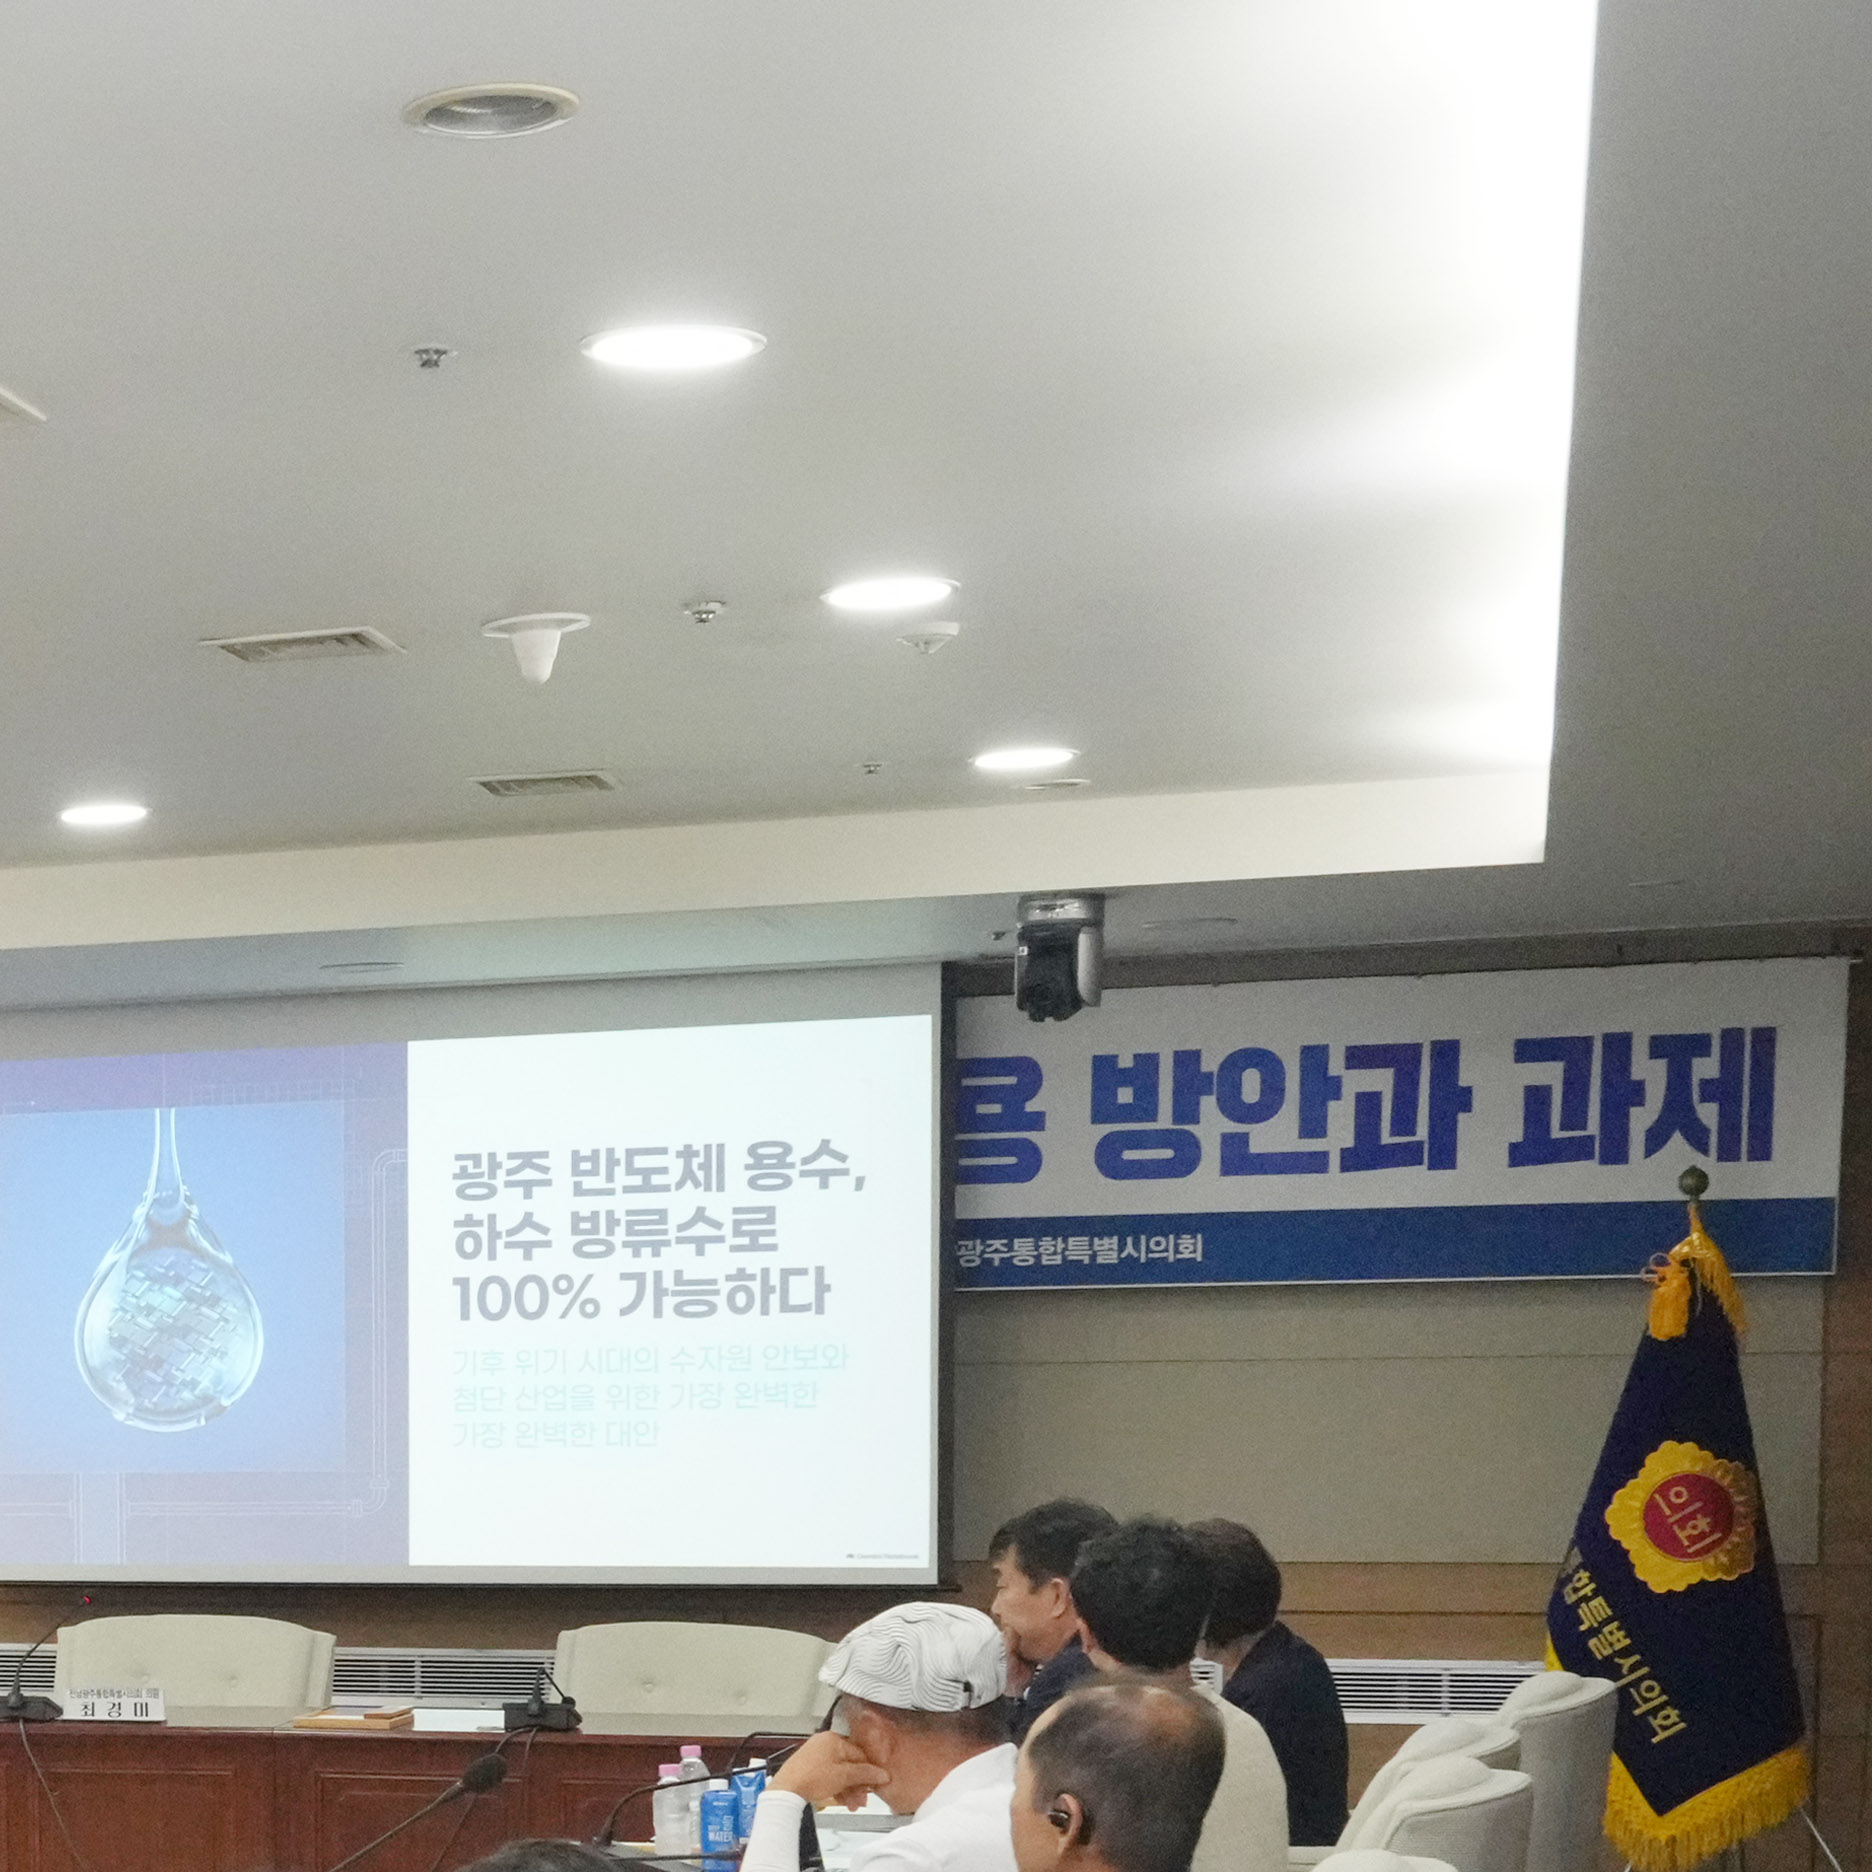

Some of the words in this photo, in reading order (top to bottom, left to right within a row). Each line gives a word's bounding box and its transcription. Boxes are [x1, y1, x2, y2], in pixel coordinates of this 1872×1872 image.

[1091, 1039, 1472, 1180] 방안과
[1508, 1026, 1777, 1168] 과제
[452, 1150, 553, 1202] 광주
[570, 1143, 726, 1197] 반도체
[744, 1138, 866, 1192] 용수,
[453, 1211, 553, 1262] 하수
[570, 1205, 779, 1260] 방류수로
[957, 1234, 1203, 1268] 광주통합특별시의회
[452, 1273, 601, 1322] 100%
[619, 1265, 832, 1319] 가능하다
[452, 1349, 507, 1377] 기후
[514, 1348, 567, 1376] 위기
[577, 1347, 661, 1375] 시대의
[668, 1345, 753, 1374] 수자원
[760, 1343, 849, 1373] 안보와
[452, 1385, 507, 1413] 첨단
[514, 1383, 596, 1412] 산업을
[604, 1382, 661, 1411] 위한
[668, 1381, 724, 1410] 가장
[733, 1380, 820, 1409] 완벽한
[452, 1420, 507, 1449] 가장
[514, 1420, 597, 1449] 완벽한
[604, 1419, 661, 1448] 대안
[1653, 1486, 1722, 1553] 의회
